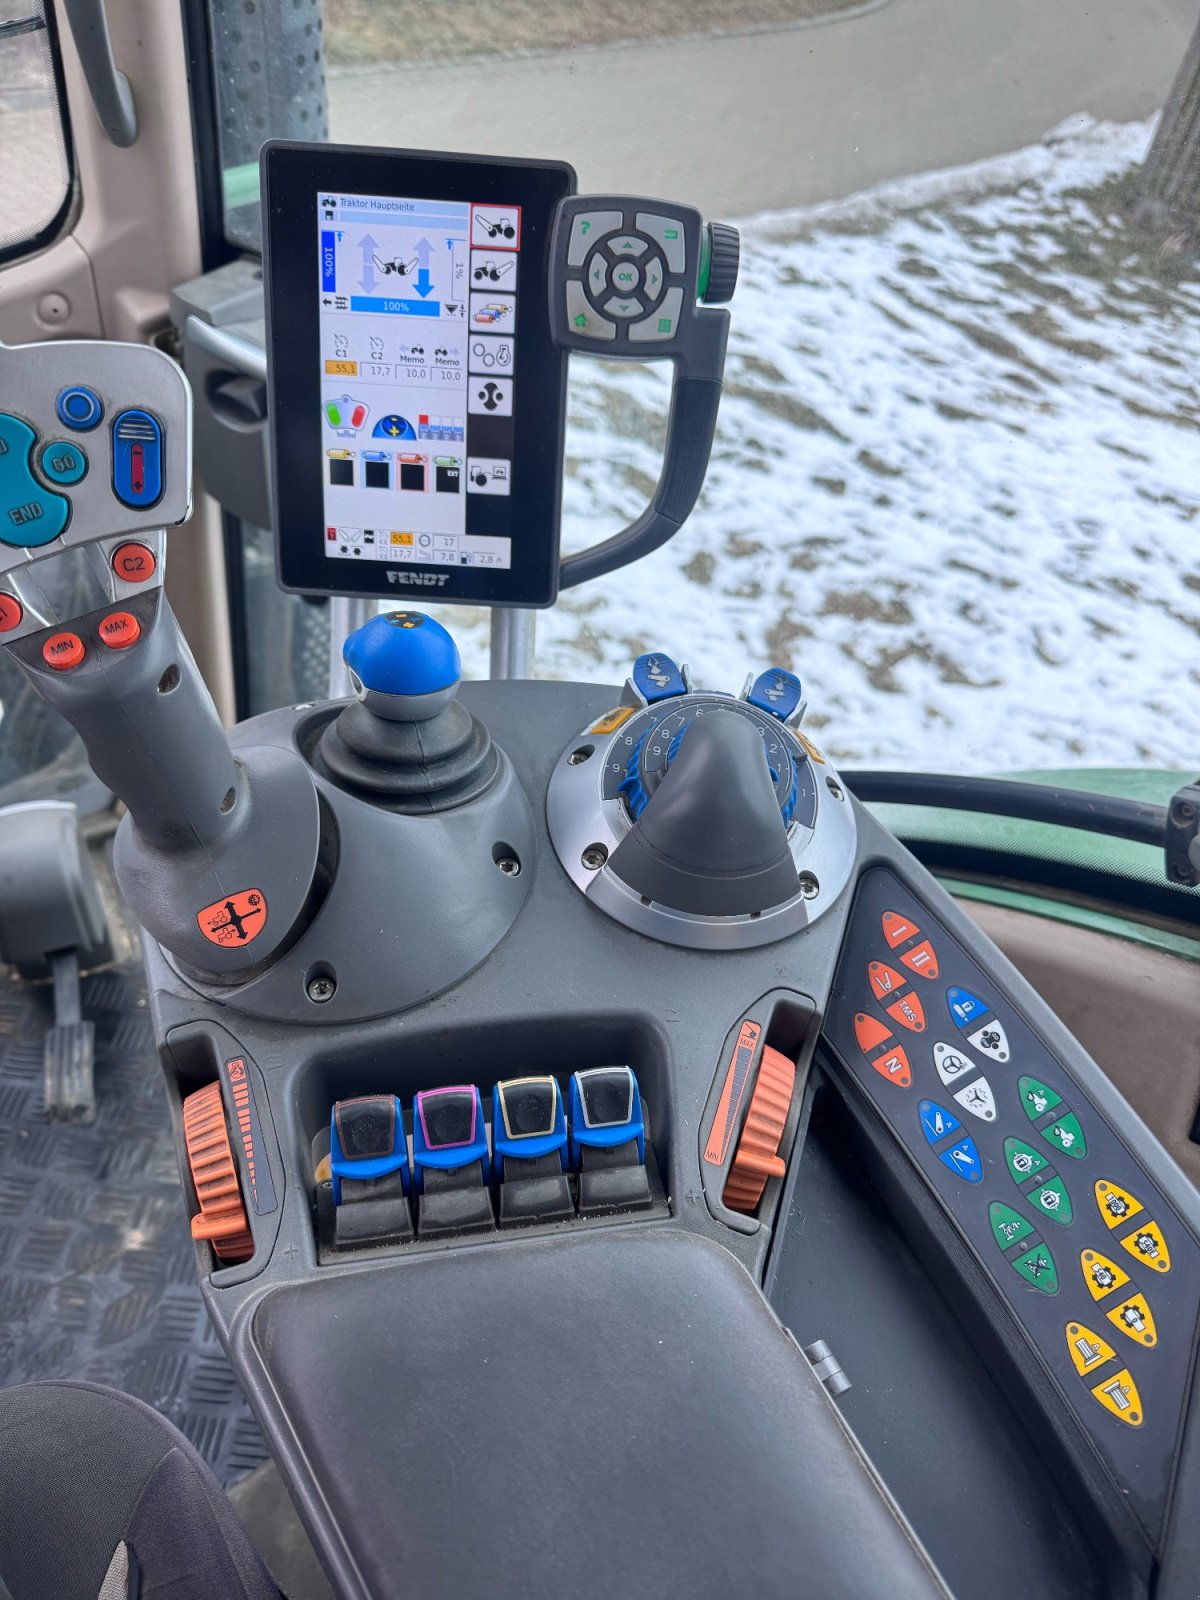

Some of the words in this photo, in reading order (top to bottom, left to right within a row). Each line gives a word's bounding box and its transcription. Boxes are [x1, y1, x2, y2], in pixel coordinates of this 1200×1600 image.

[340, 198, 369, 208] Traktor
[371, 201, 415, 212] Hauptseite
[581, 221, 590, 235] ?
[325, 247, 333, 277] 100%
[455, 263, 463, 279] 1%
[618, 272, 633, 282] OK
[383, 301, 410, 313] 100%
[335, 349, 348, 358] C1
[371, 352, 383, 360] C2
[400, 355, 425, 364] Memo
[435, 357, 460, 366] Memo
[335, 363, 356, 374] 55,1
[371, 366, 391, 377] 17,7
[406, 368, 426, 379] 10,0
[441, 371, 461, 382] 10,0
[52, 454, 75, 472] GO
[9, 503, 44, 525] END
[392, 534, 412, 544] 55,1
[444, 538, 454, 546] 17
[393, 549, 412, 559] 17,7
[123, 556, 145, 572] C2
[386, 570, 450, 586] FENDT
[104, 618, 129, 635] MAX
[51, 639, 74, 656] MIN
[677, 716, 685, 726] 7
[661, 729, 669, 739] 8
[625, 736, 633, 745] 8
[653, 746, 661, 756] 9
[769, 744, 778, 754] 2
[612, 763, 620, 773] 9
[777, 763, 781, 773] 1
[802, 788, 806, 798] 1
[899, 999, 917, 1023] TMS
[740, 1037, 754, 1048] MAX
[884, 1056, 903, 1075] N
[706, 1150, 719, 1162] MIN
[1108, 1195, 1121, 1211] 1000
[1141, 1239, 1156, 1255] 540E
[1095, 1268, 1107, 1280] 540
[1092, 1343, 1100, 1352] A
[1121, 1386, 1130, 1395] A
